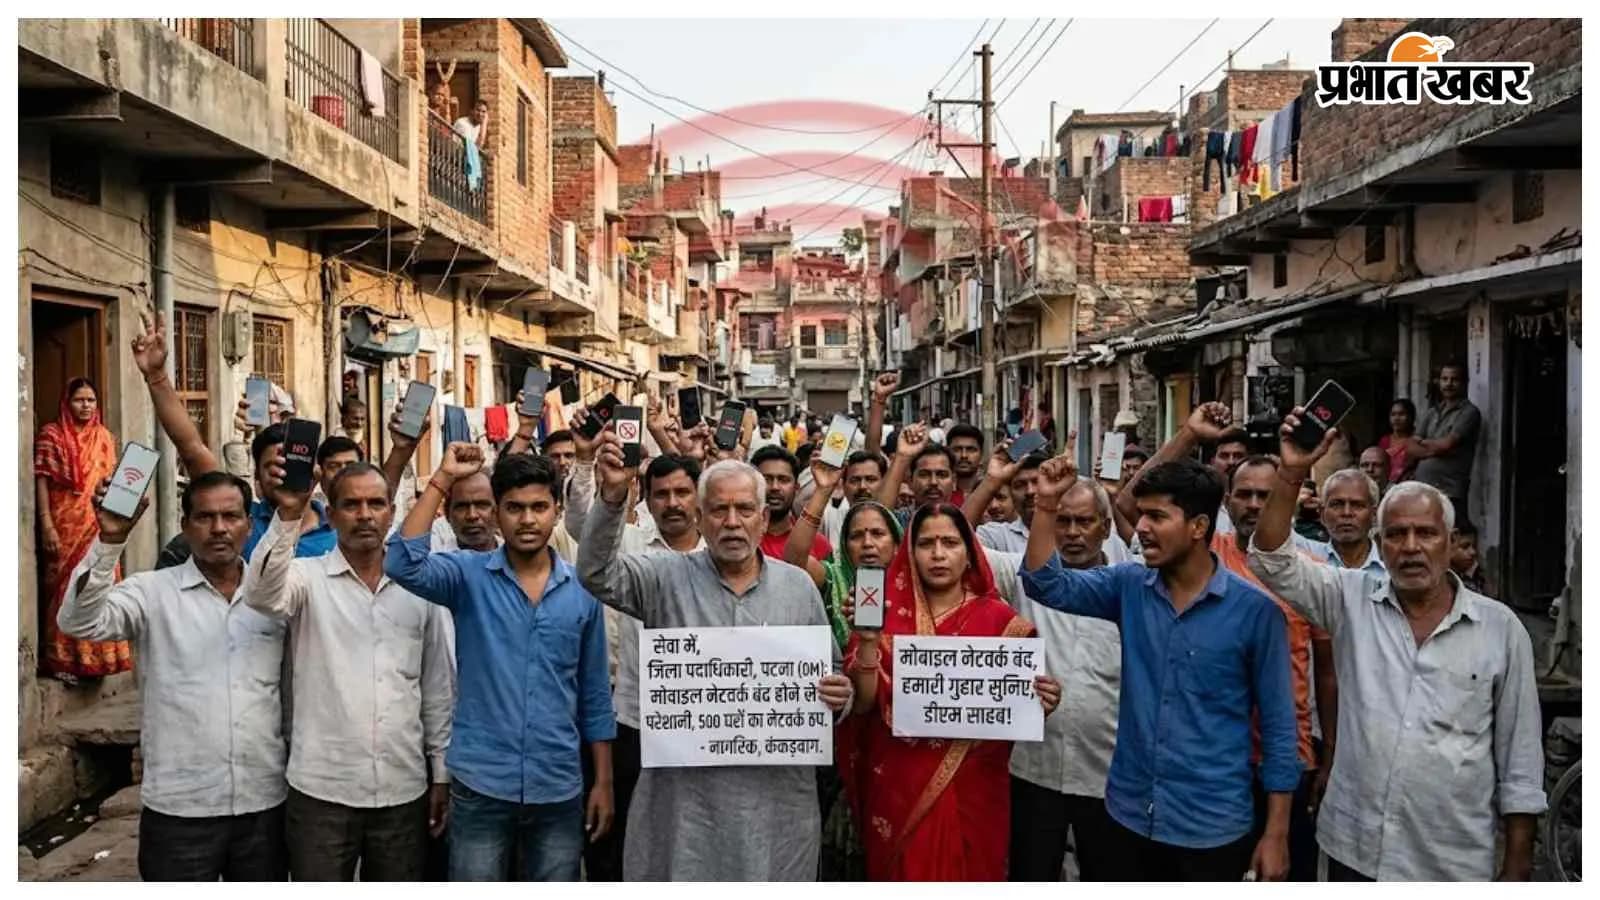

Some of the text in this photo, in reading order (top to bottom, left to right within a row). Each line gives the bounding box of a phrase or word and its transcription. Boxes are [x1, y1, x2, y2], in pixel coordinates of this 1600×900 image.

[652, 633, 700, 656] सेवा में,
[960, 644, 1009, 668] नेटवर्क
[647, 659, 682, 679] जिला
[684, 656, 757, 679] पदाधिकारी,
[760, 661, 795, 677] पटना
[705, 682, 748, 703] नेटवर्क
[775, 682, 801, 703] होने
[901, 672, 1034, 701] हमारी गुहार सुनिए,
[646, 707, 828, 731] परेशानी, 500 घरों का नेटवर्क ठप.
[923, 701, 1012, 725] डीएम साहब!
[708, 734, 762, 757] नागरिक,
